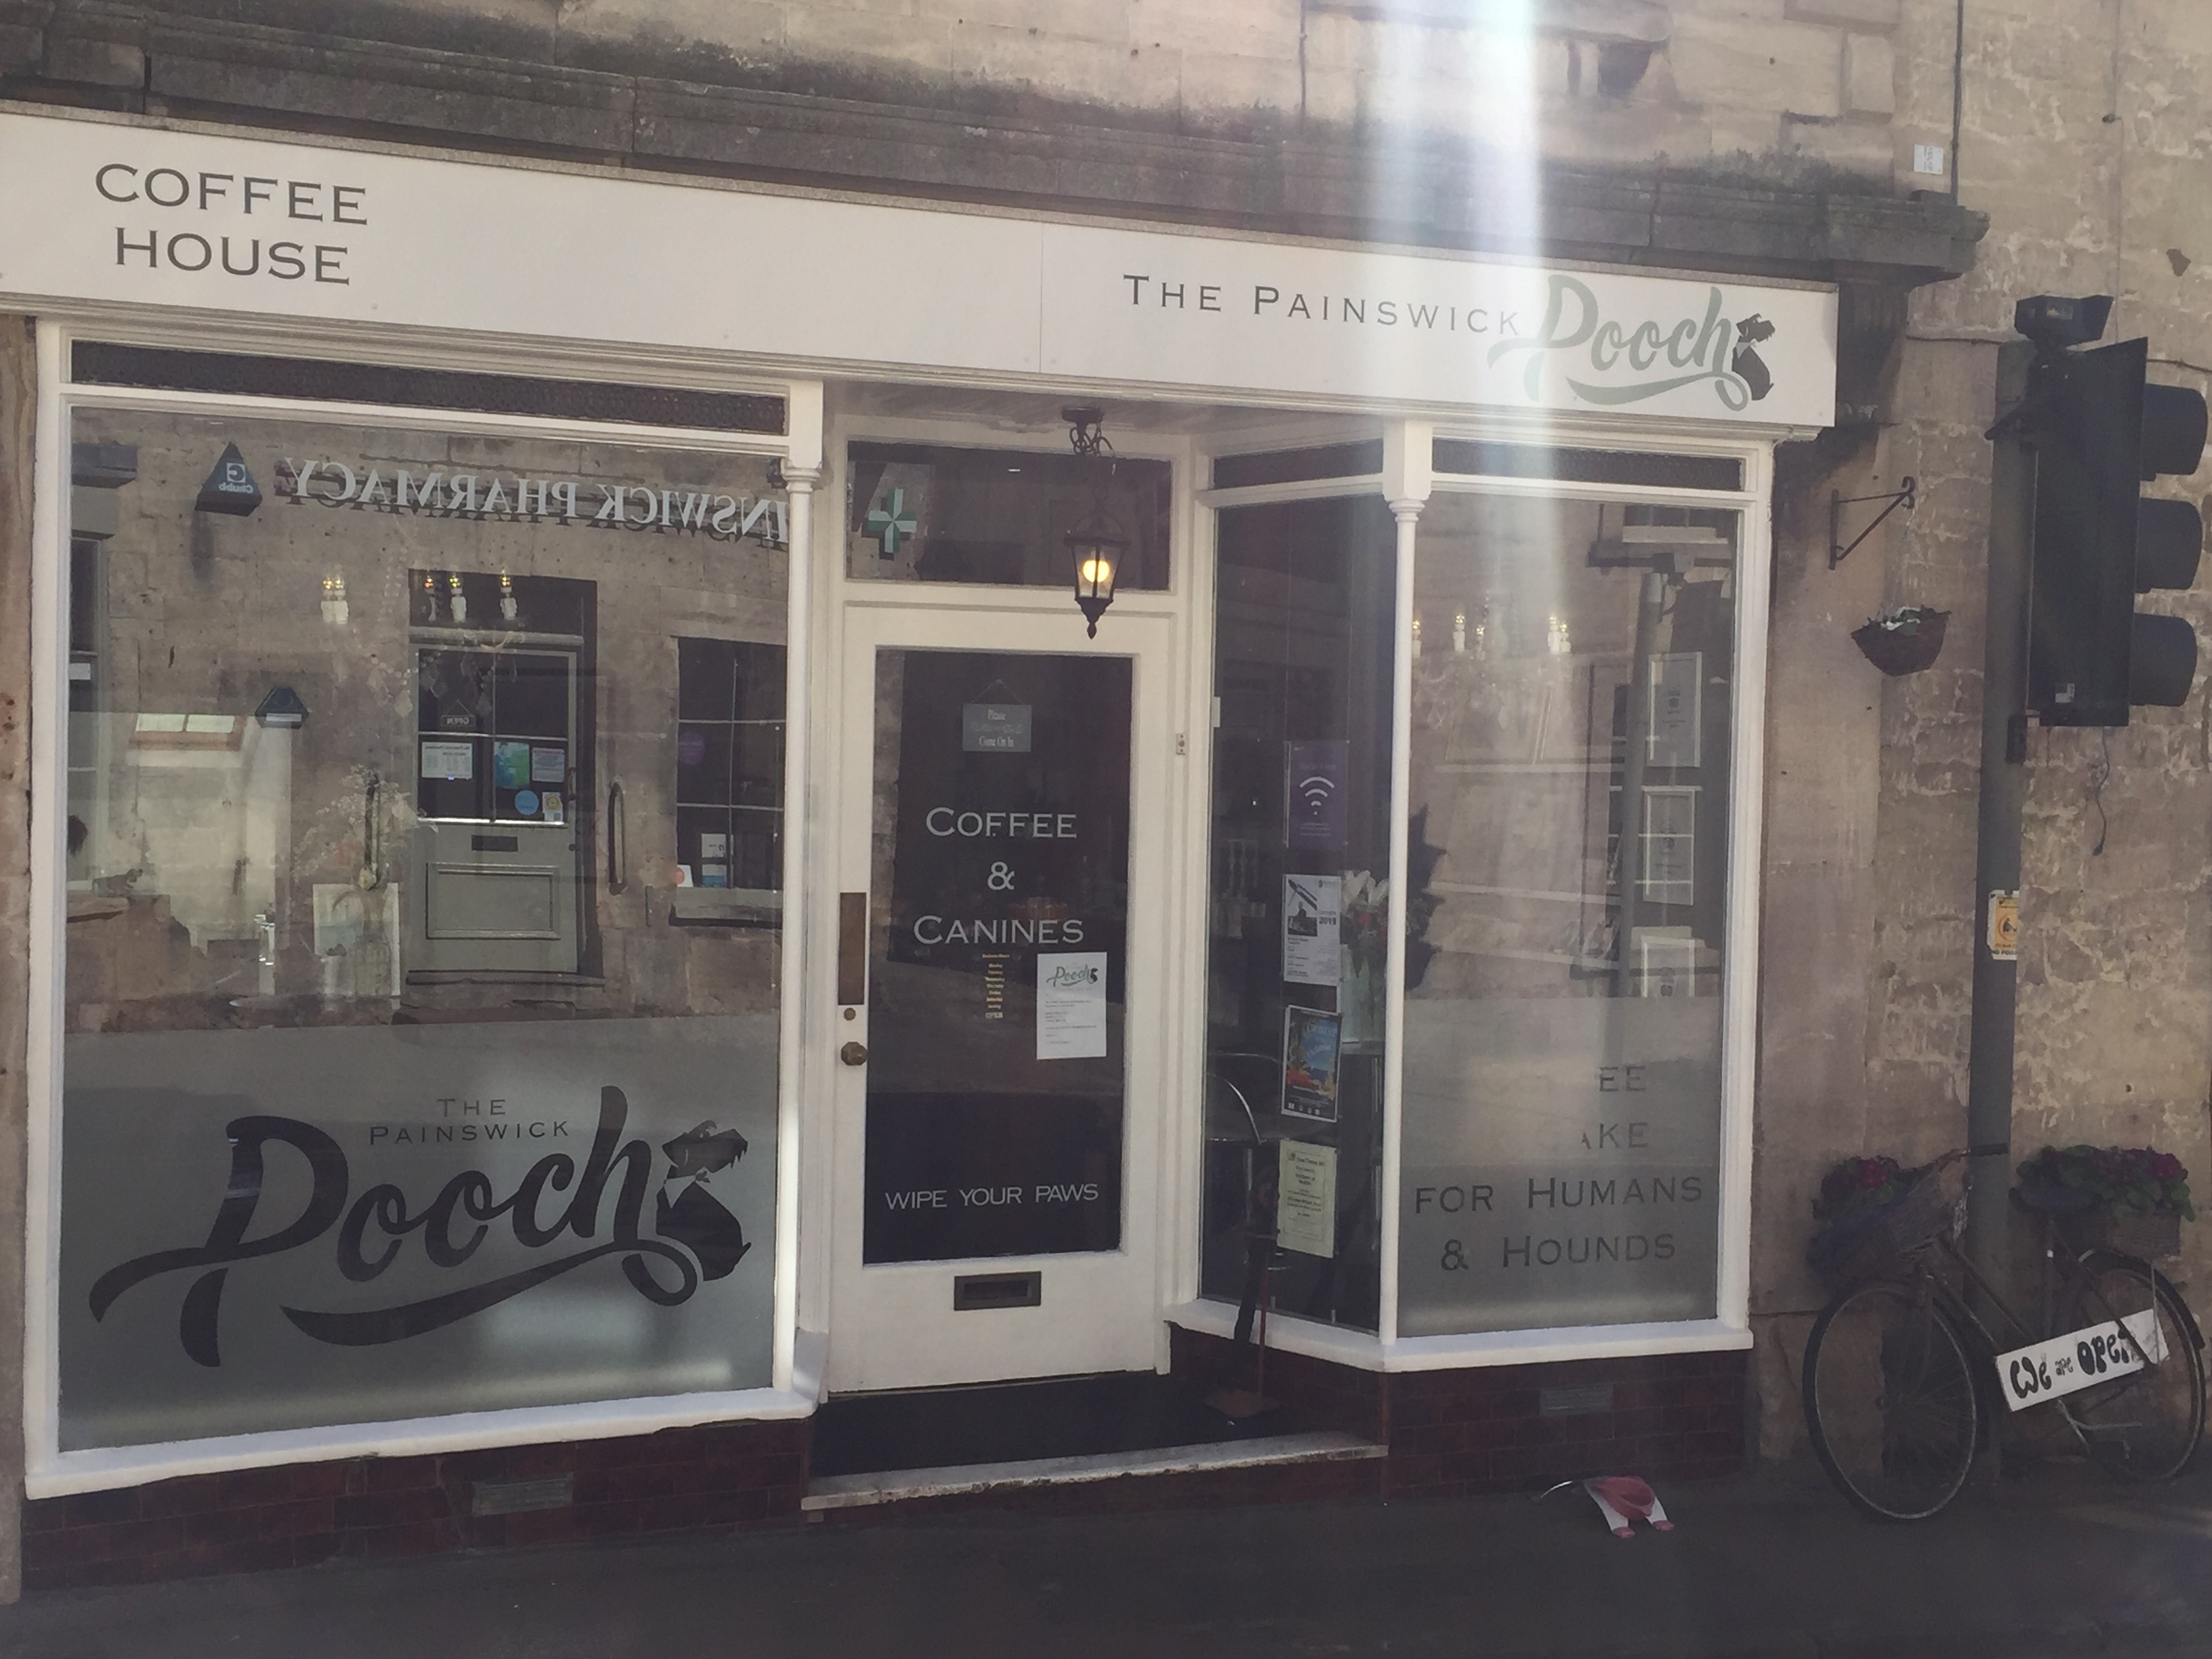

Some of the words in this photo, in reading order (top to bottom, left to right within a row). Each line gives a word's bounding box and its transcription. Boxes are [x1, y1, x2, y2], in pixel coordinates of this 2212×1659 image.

[96, 163, 368, 225] COFFEE
[116, 227, 350, 285] HOUSE
[1123, 274, 1222, 312] THE
[1253, 285, 1519, 336] PAINSWICK
[1487, 274, 1748, 411] Pooch
[926, 806, 1078, 838] COFFEE
[987, 861, 1015, 890] &
[913, 915, 1084, 945] CANINES
[1319, 917, 1337, 926] 2019
[437, 1099, 506, 1118] THE
[369, 1121, 569, 1145] PAINSWICK
[885, 1189, 947, 1210] WIPE
[959, 1187, 1023, 1206] YOUR
[1035, 1183, 1099, 1202] PAWS
[1415, 1185, 1494, 1214] FOR
[1528, 1176, 1702, 1209] HUMANS
[89, 1085, 697, 1368] Pooch
[1441, 1239, 1469, 1271] &
[1502, 1234, 1675, 1267] HOUNDS
[2010, 1357, 2052, 1399] We
[2055, 1358, 2074, 1376] are
